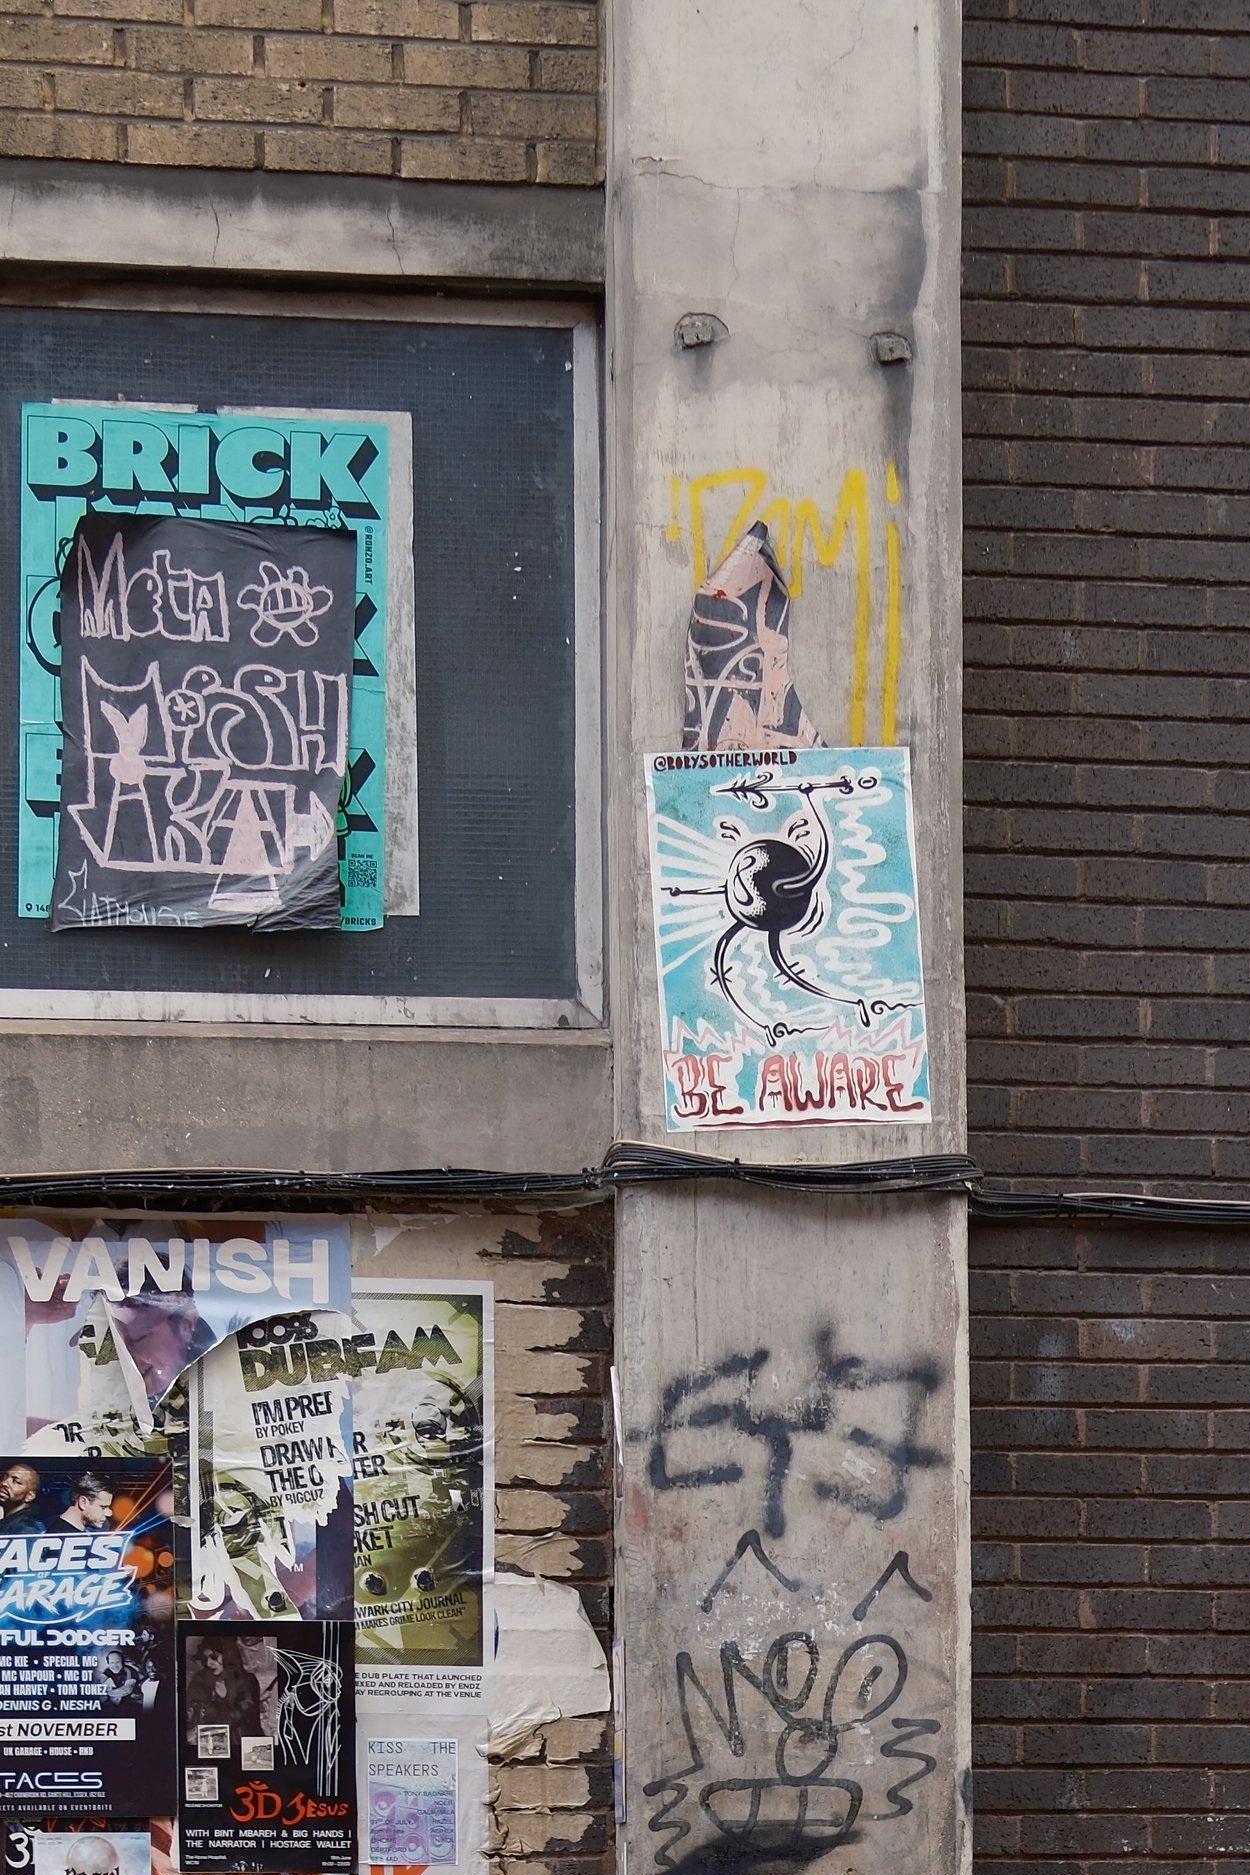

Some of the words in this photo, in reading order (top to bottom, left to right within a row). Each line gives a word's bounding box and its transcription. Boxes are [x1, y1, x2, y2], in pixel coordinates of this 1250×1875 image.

[26, 414, 380, 518] BRICK
[364, 523, 374, 585] @RONZO.ART
[671, 1052, 745, 1118] BE
[759, 1051, 925, 1113] AWARE
[8, 1236, 330, 1305] VANISH
[255, 1426, 270, 1439] BY
[271, 1420, 305, 1438] POKEY
[260, 1436, 324, 1468] DRAW
[265, 1470, 308, 1493] THE
[269, 1494, 285, 1508] BY
[381, 1495, 421, 1522] CUT
[390, 1599, 414, 1615] CITY
[416, 1592, 467, 1611] JOURNAL
[361, 1617, 389, 1630] MAKES
[415, 1609, 436, 1622] LOOK
[46, 1629, 136, 1647] DODGER
[43, 1656, 80, 1667] SPECIAL
[82, 1656, 98, 1667] MC
[1, 1670, 17, 1682] MC
[19, 1670, 55, 1682] VAPOUR
[64, 1670, 80, 1682] MC
[13, 1685, 48, 1696] HARVEY
[57, 1685, 79, 1696] TOM
[398, 1681, 444, 1689] RELOADED
[367, 1689, 423, 1697] REGROUPING
[423, 1689, 435, 1697] AT
[437, 1690, 453, 1698] THE
[453, 1690, 482, 1698] VENUE
[60, 1700, 102, 1711] NESHA
[17, 1723, 119, 1737] NOVEMBER
[3, 1747, 14, 1756] UK
[14, 1747, 43, 1756] GARAGE
[49, 1747, 73, 1756] HOUSE
[368, 1741, 404, 1754] KISS
[432, 1741, 456, 1754] THE
[368, 1763, 439, 1777] SPEAKERS
[185, 1829, 210, 1838] WITH
[214, 1829, 235, 1838] BINT
[238, 1829, 277, 1838] MBAREH
[281, 1830, 289, 1838] &
[293, 1830, 308, 1838] BIG
[313, 1830, 344, 1838] HANDS
[185, 1840, 204, 1848] THE
[208, 1840, 257, 1849] NARRATOR
[269, 1840, 312, 1849] HOSTAGE
[316, 1841, 352, 1849] WALLET
